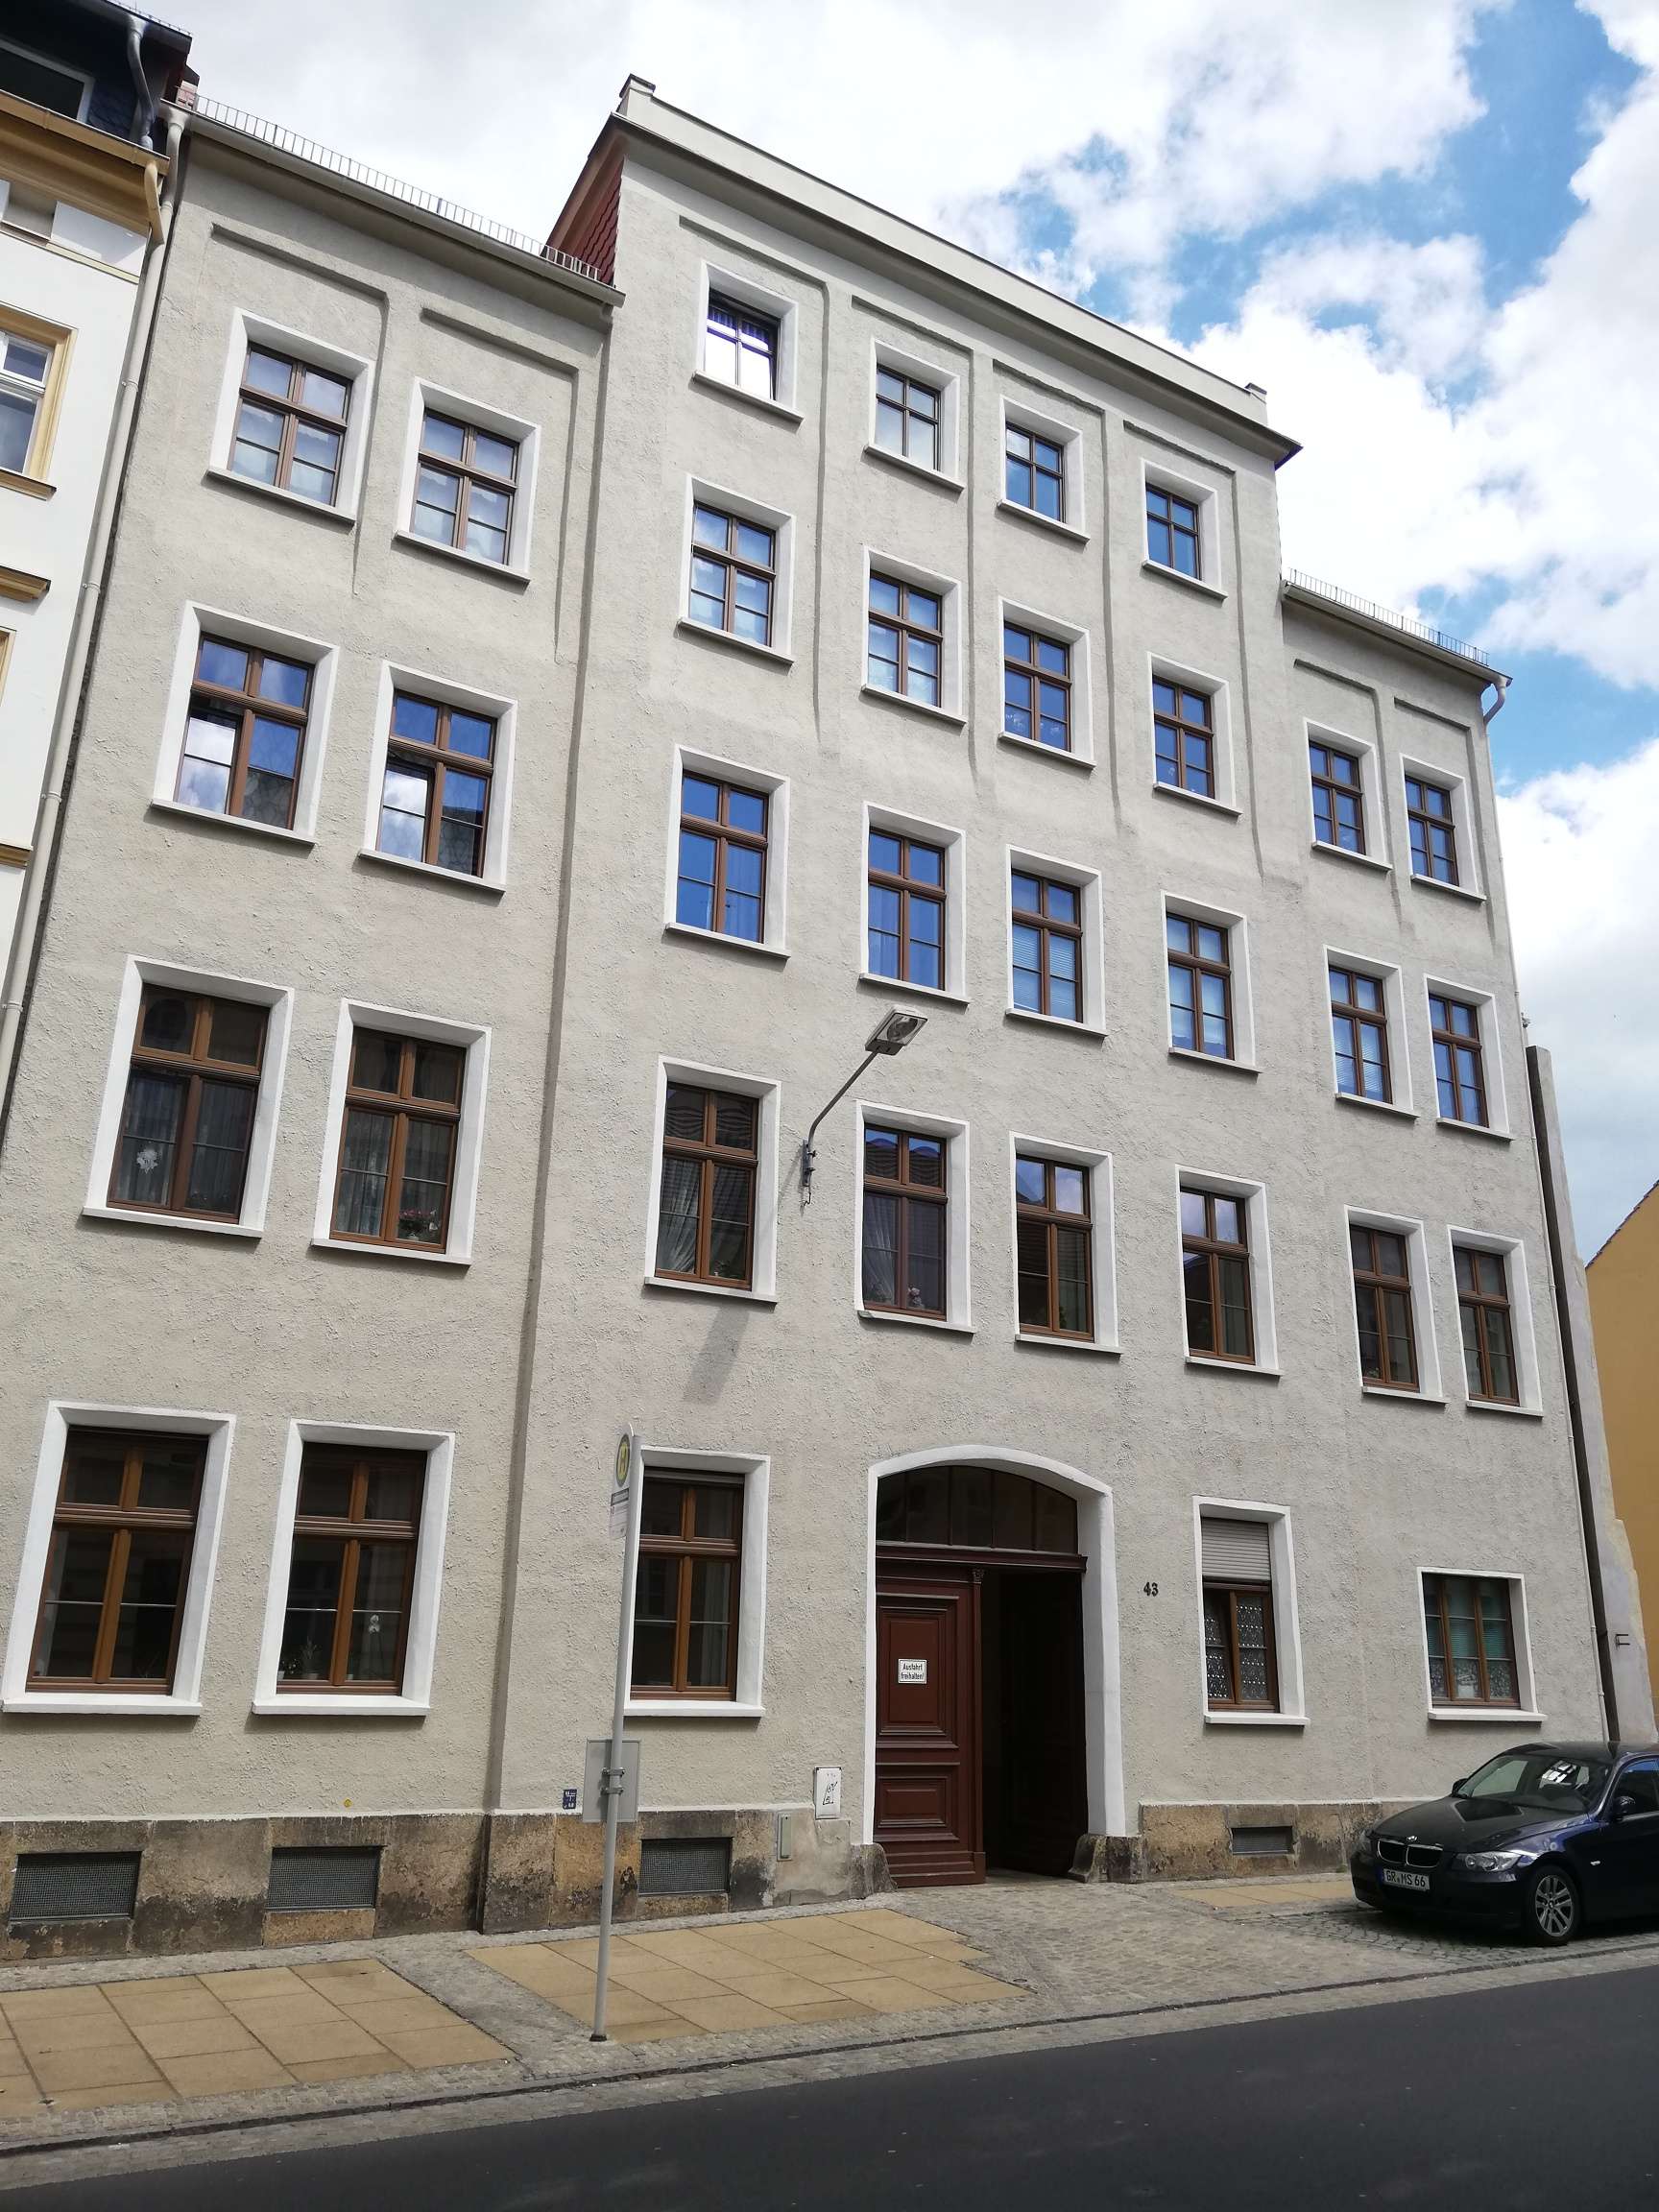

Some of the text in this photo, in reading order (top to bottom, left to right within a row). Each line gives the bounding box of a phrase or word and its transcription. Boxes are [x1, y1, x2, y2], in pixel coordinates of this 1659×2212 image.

[1143, 1581, 1159, 1597] 43
[1385, 1870, 1396, 1883] GR
[1414, 1874, 1426, 1887] 66
